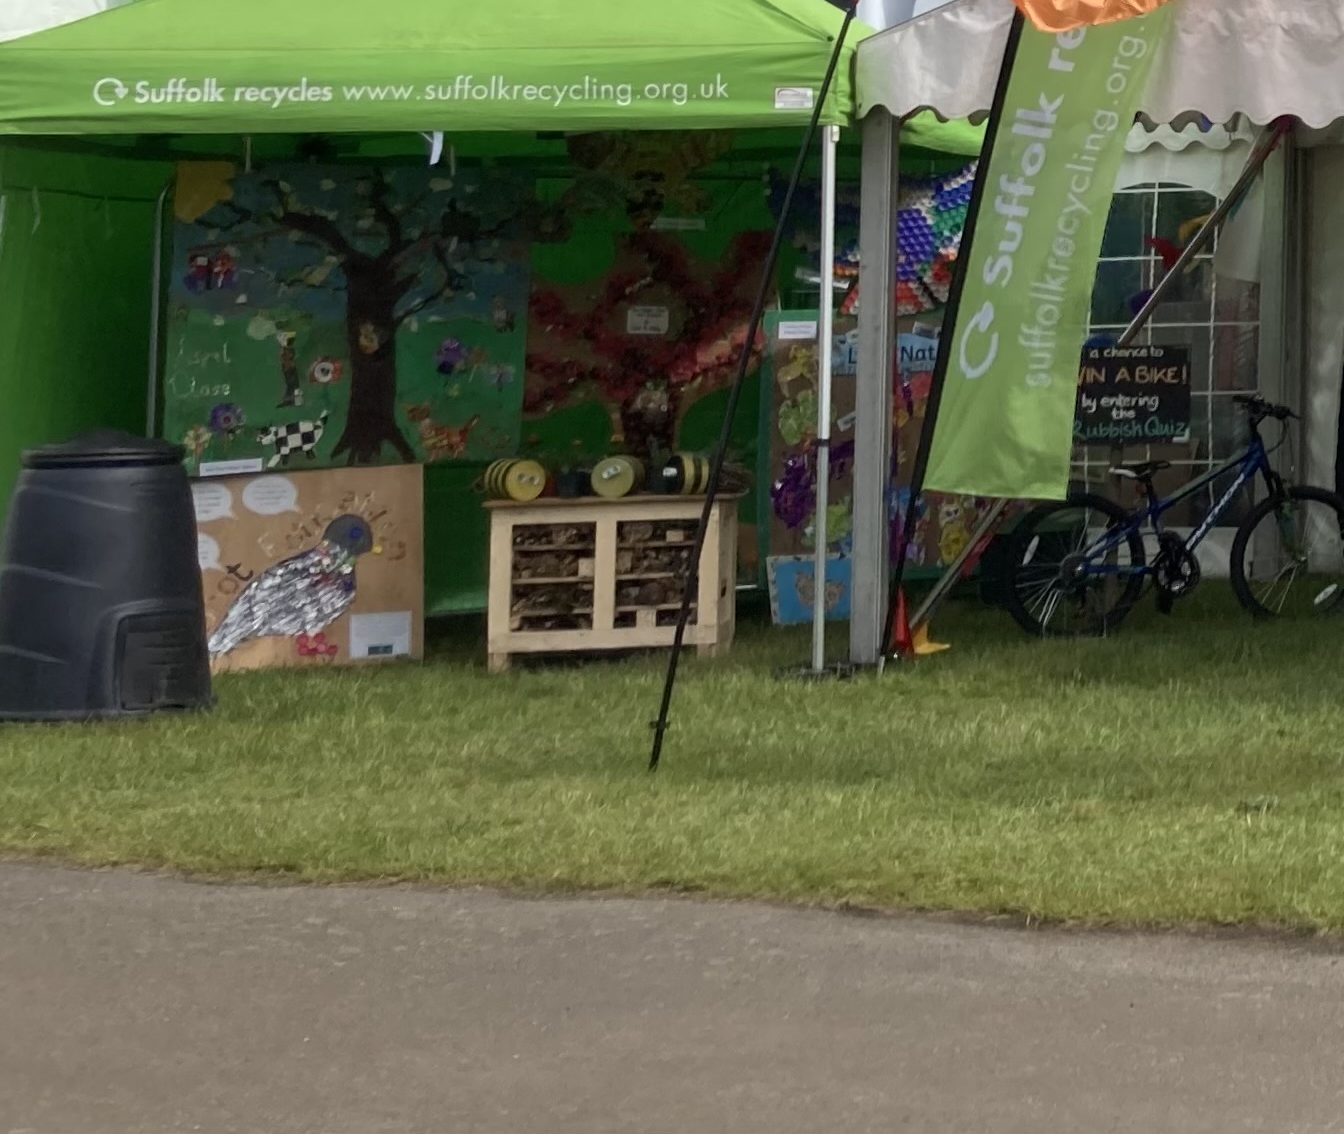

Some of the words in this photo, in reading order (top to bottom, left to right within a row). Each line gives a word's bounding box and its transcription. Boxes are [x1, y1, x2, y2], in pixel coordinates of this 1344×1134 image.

[134, 77, 225, 104] Suffolk
[234, 77, 332, 108] recycles
[342, 73, 729, 107] www.suffolkrecycling.org.uk
[983, 91, 1065, 288] Suffolk
[1150, 346, 1165, 357] to
[1115, 366, 1131, 384] A
[1135, 364, 1187, 385] BIKE!
[1081, 393, 1097, 413] by
[1100, 391, 1160, 412] entering
[1111, 408, 1136, 420] the
